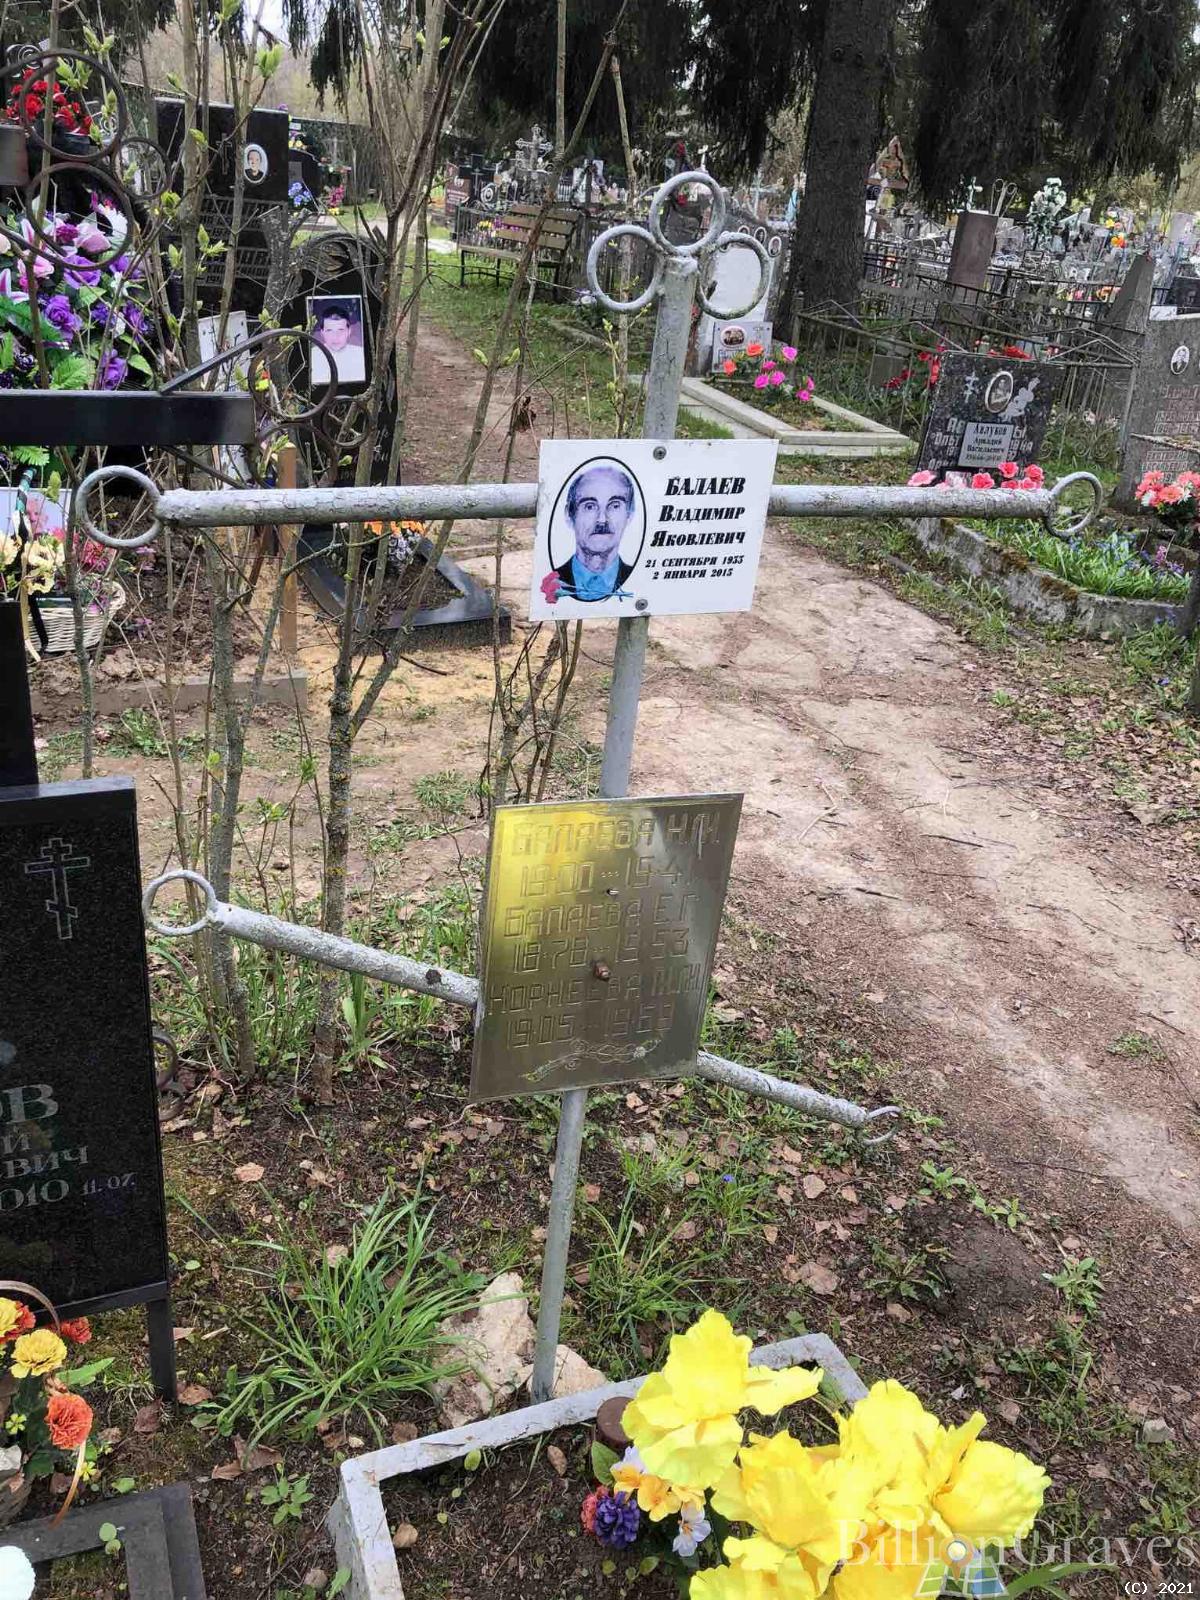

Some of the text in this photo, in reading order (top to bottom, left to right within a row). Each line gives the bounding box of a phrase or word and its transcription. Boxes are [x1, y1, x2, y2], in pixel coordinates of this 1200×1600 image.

[664, 476, 746, 496] БАЛАЕВ
[645, 559, 657, 568] 21
[661, 556, 718, 567] СЕНТЯБРЯ
[652, 571, 660, 580] 2
[664, 569, 707, 579] ЯНВАРЯ
[0, 1145, 89, 1179] ВИЧ
